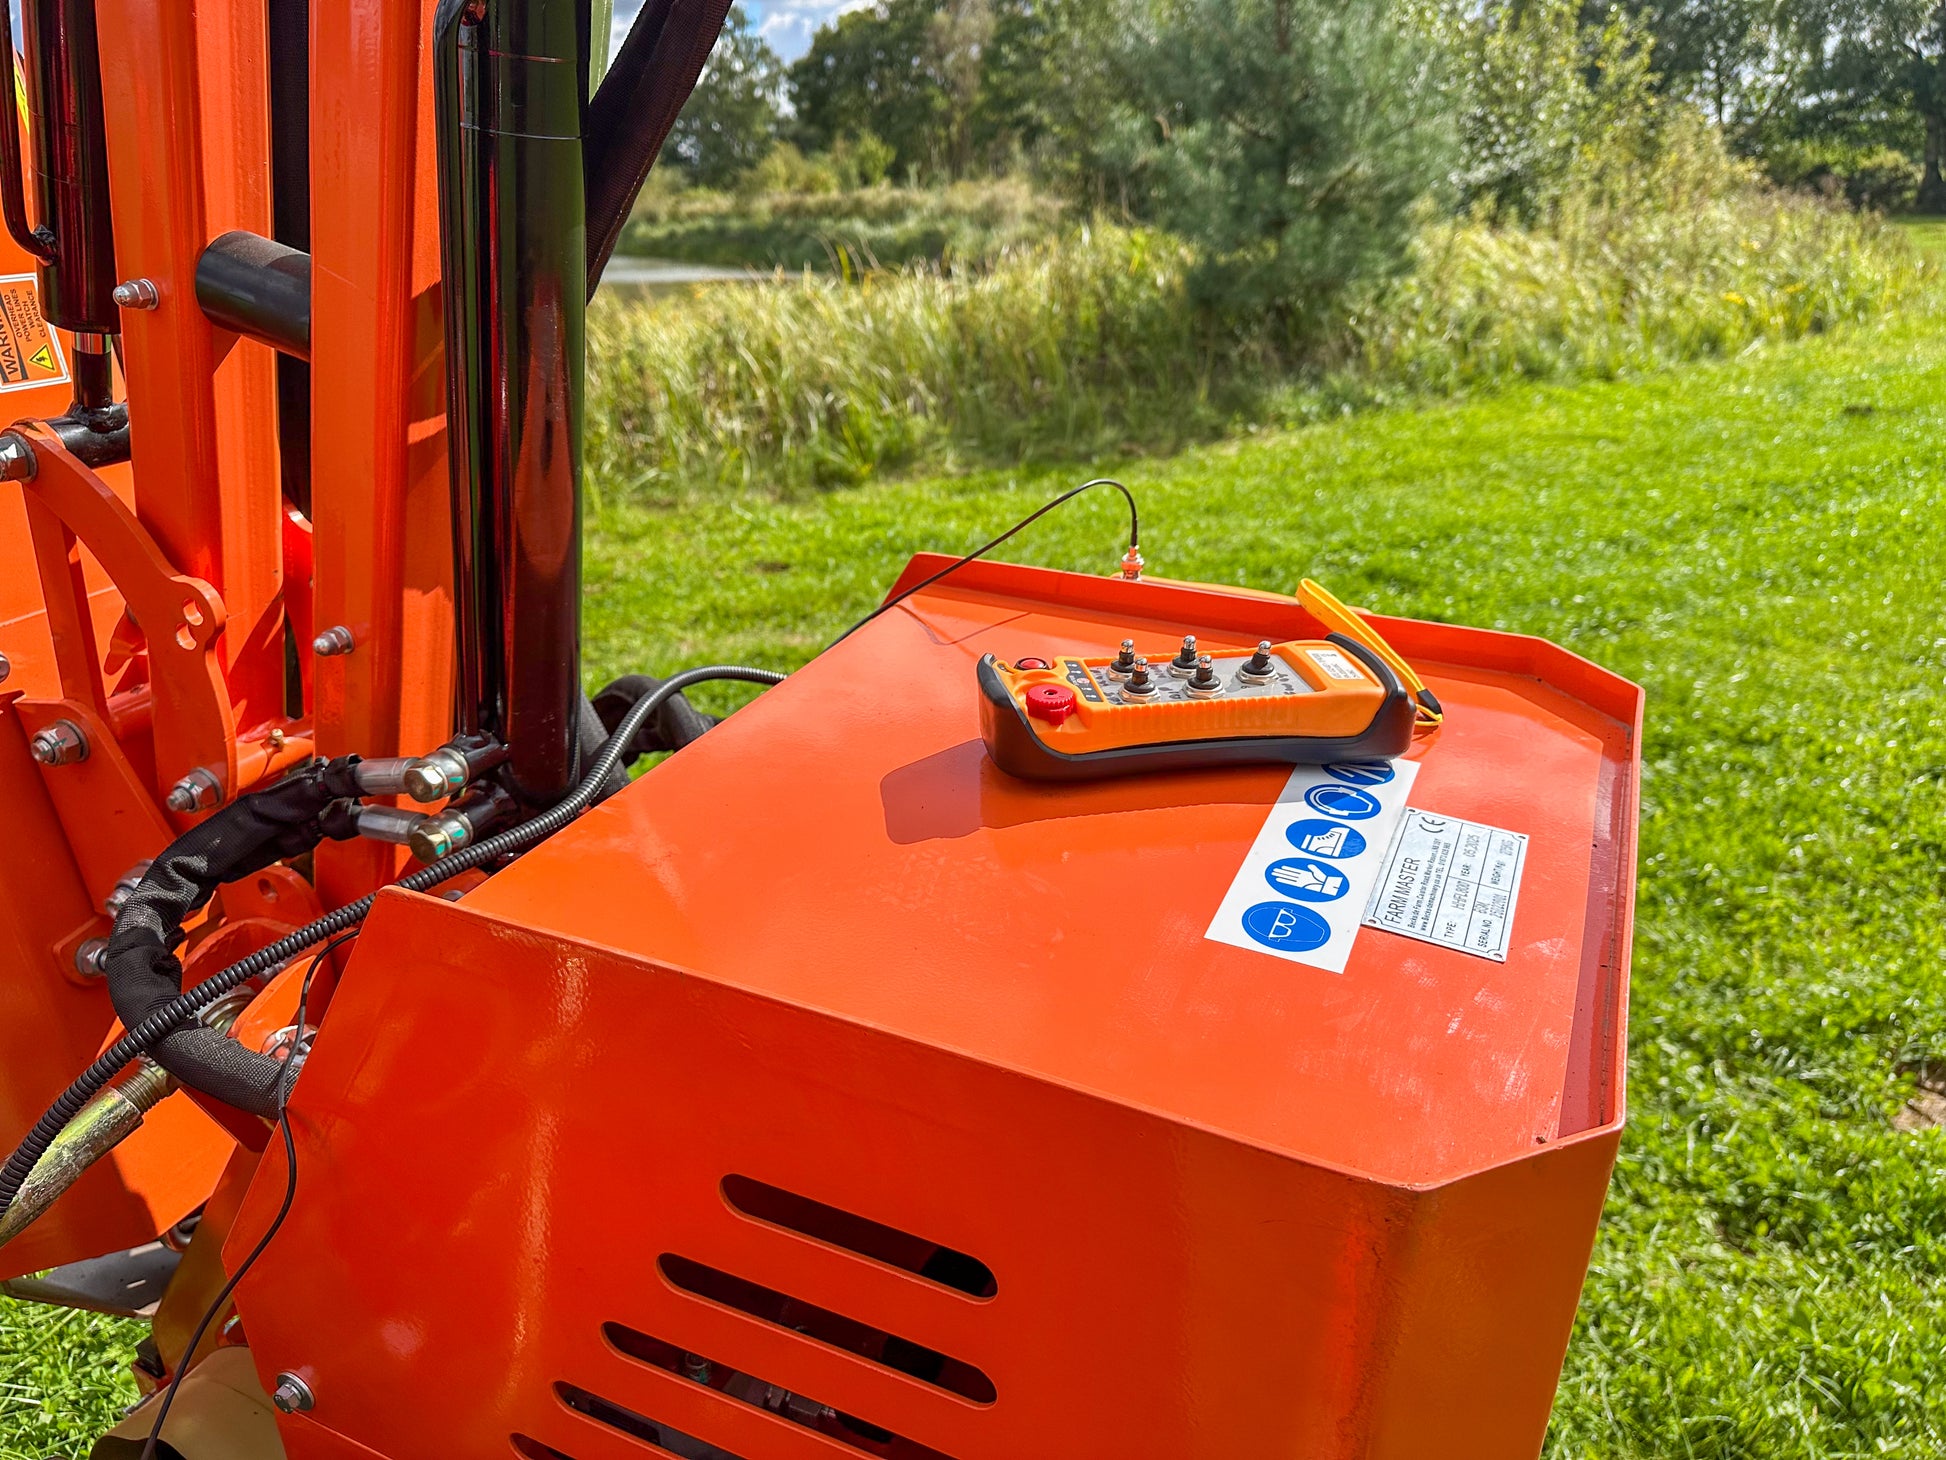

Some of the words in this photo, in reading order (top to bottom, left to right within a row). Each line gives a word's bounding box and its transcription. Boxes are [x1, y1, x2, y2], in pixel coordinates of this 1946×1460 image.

[10, 288, 22, 314] LINES
[22, 300, 35, 328] WATCH
[26, 290, 46, 338] CLEARANCE
[4, 294, 23, 338] OVERHEAD
[18, 314, 32, 342] POWER
[1419, 816, 1446, 834] CE
[1392, 856, 1420, 896] MASTER
[1383, 894, 1408, 924] FARM
[1444, 919, 1457, 938] TYPE:
[1476, 926, 1490, 948] SERIAL
